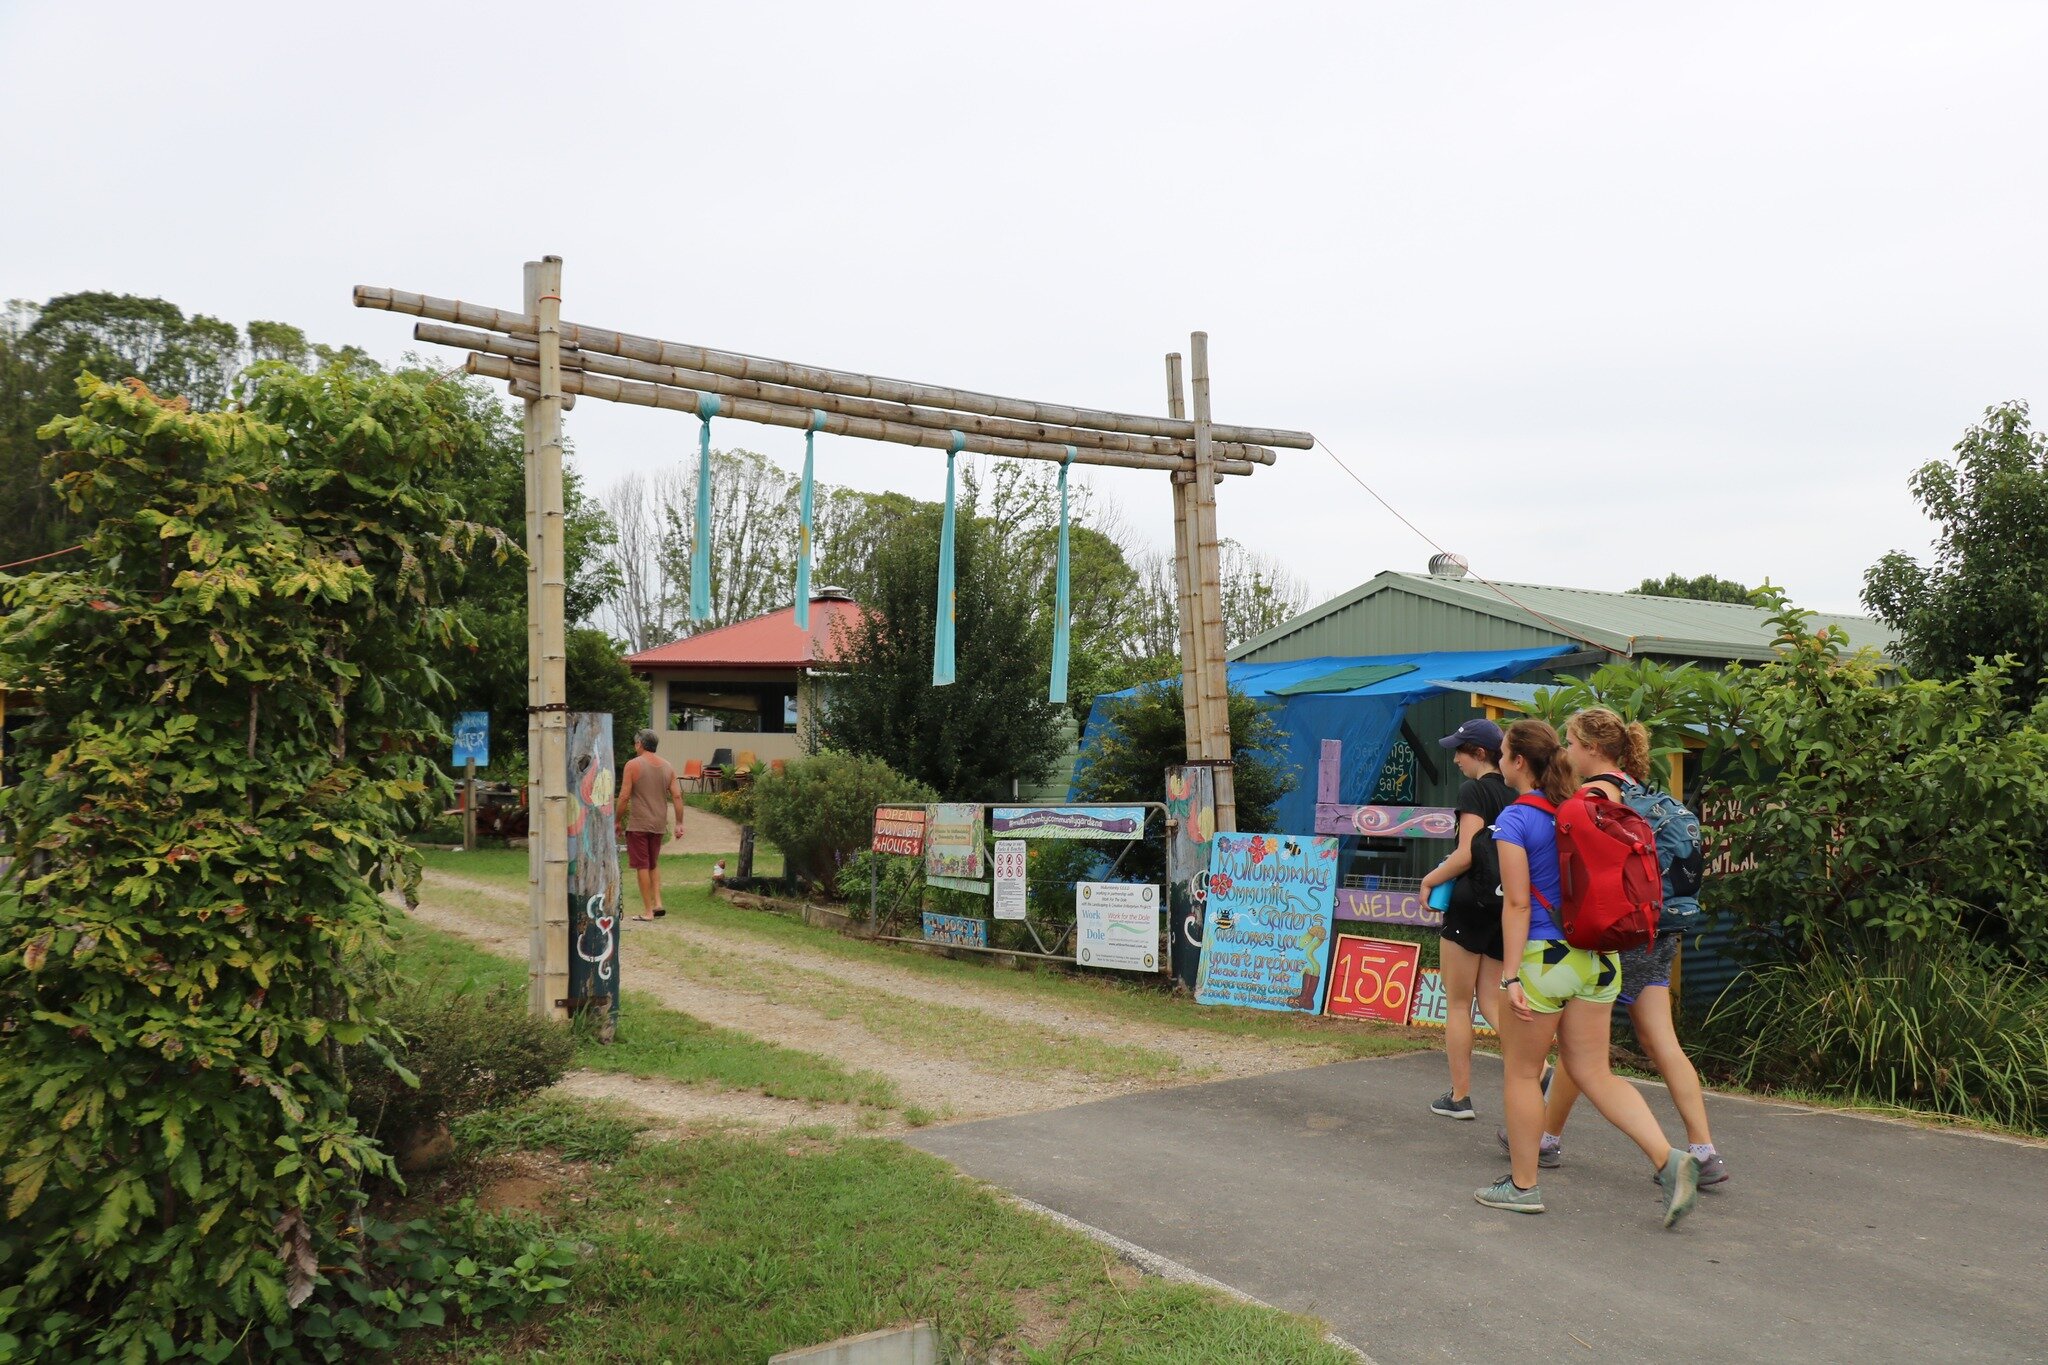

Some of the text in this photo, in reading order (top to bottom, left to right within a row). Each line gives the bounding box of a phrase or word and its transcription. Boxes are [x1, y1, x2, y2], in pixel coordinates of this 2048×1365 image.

[885, 809, 913, 820] OPEN
[1217, 850, 1328, 887] Mullumbimby
[1082, 910, 1101, 920] Work
[1259, 904, 1325, 931] Gardens
[1349, 894, 1442, 923] WELCO
[945, 919, 968, 933] DOGS
[1086, 928, 1105, 940] Dole
[1276, 933, 1303, 951] you
[1334, 954, 1409, 1008] 156
